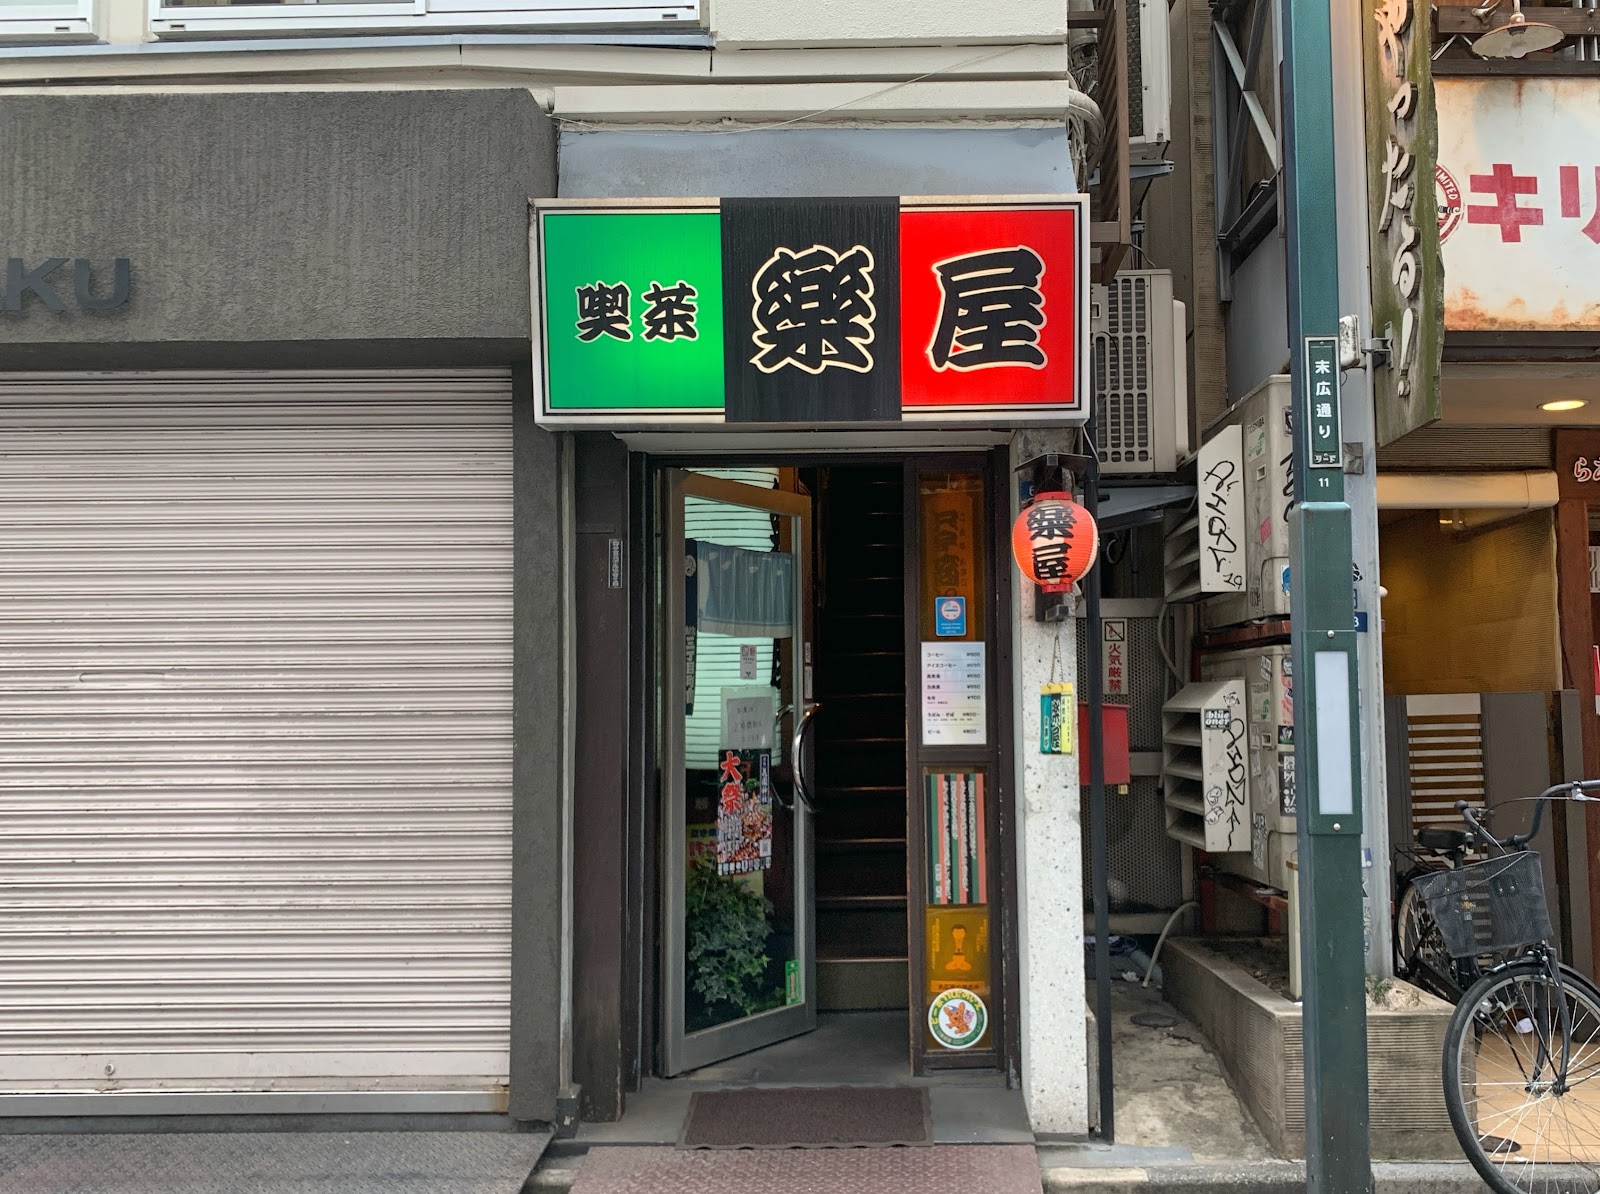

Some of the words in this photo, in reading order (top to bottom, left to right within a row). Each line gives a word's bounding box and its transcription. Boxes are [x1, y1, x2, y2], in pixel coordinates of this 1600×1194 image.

[1435, 166, 1459, 201] IMITED
[0, 258, 130, 311] KU
[575, 279, 700, 343] 喫茶
[1315, 360, 1332, 438] 末広通り
[1318, 477, 1330, 488] 11
[1108, 643, 1122, 692] 火気厳禁
[720, 751, 743, 815] 大祭
